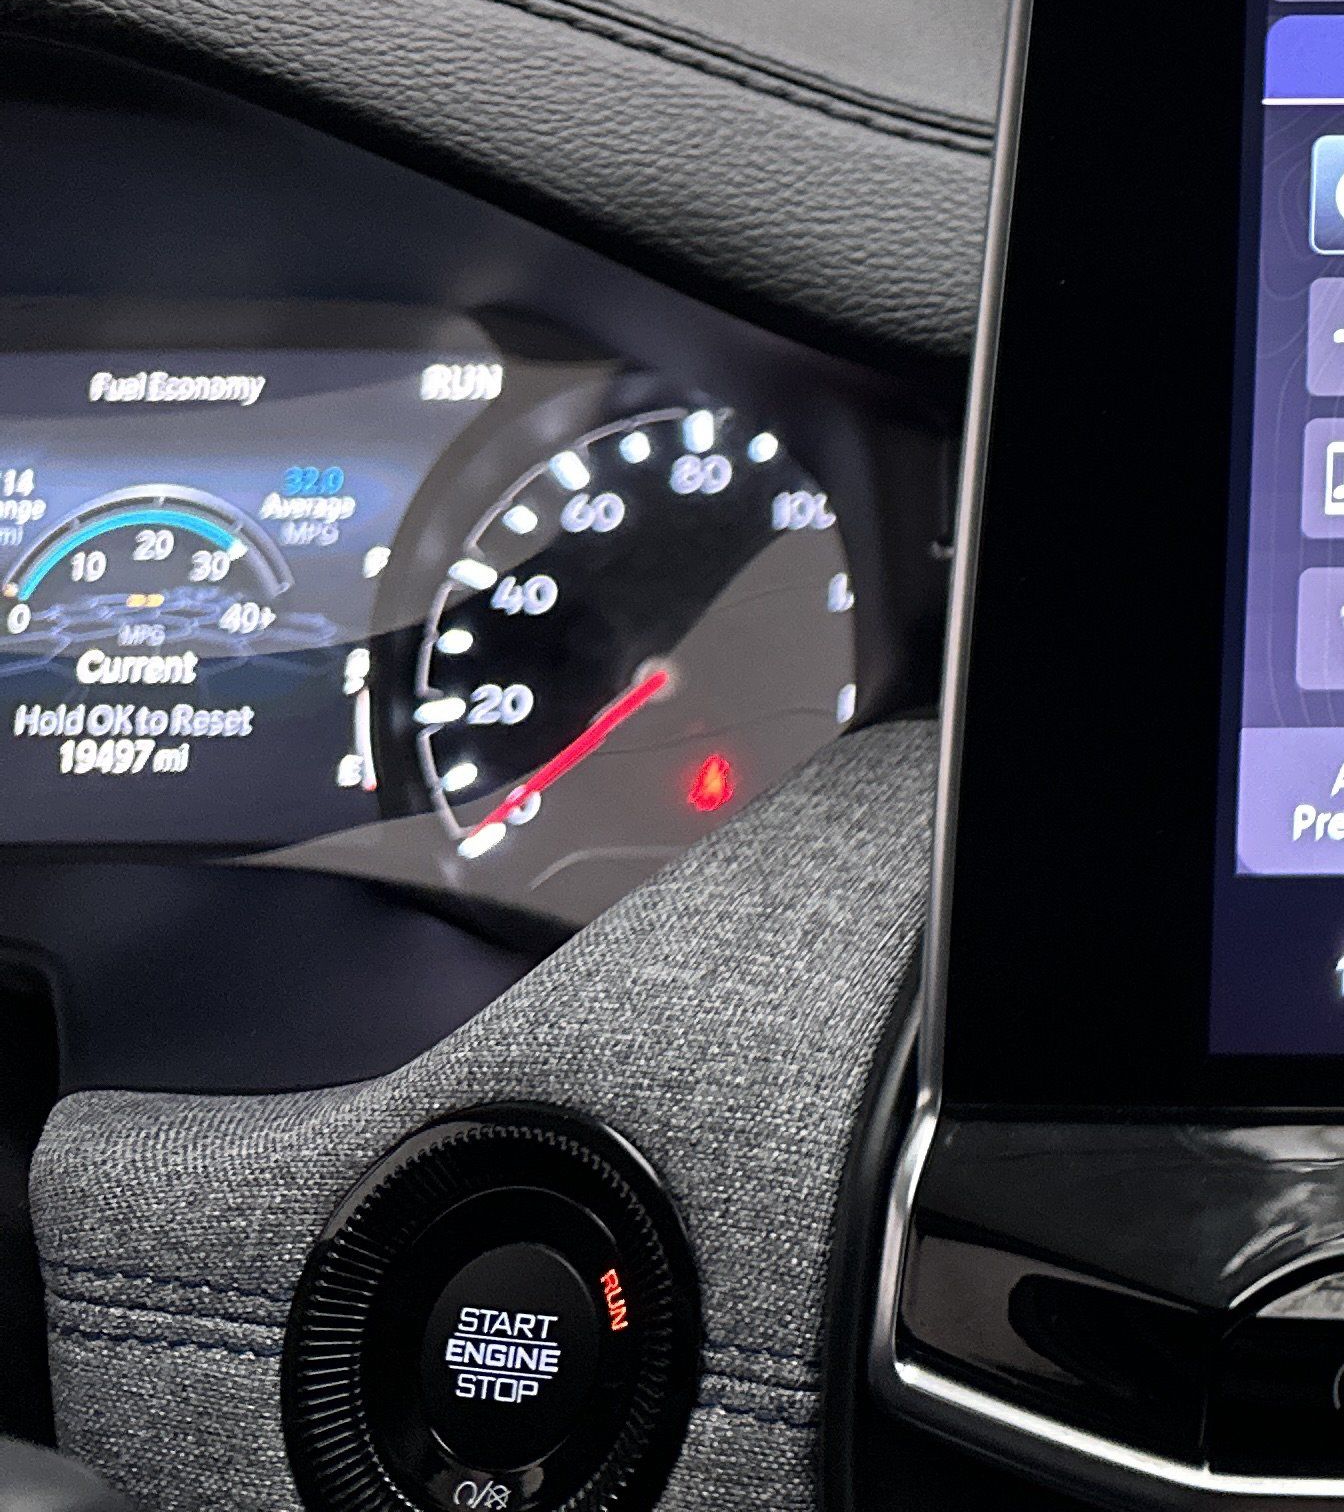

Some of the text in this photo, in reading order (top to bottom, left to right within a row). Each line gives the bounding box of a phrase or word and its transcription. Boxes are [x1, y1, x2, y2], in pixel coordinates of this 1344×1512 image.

[89, 371, 266, 406] Fuel Economy
[421, 363, 503, 400] RUN
[0, 468, 35, 497] 14
[670, 454, 732, 494] 80
[0, 499, 47, 525] nge
[259, 492, 356, 523] Average
[561, 492, 625, 533] 60
[133, 530, 174, 561] 20
[71, 551, 107, 582] 10
[189, 550, 230, 582] 30
[490, 574, 558, 616] 40
[7, 603, 31, 634] 0
[76, 649, 198, 684] Current
[14, 703, 255, 736] Hold OK to Reset
[467, 684, 534, 725] 20
[60, 738, 190, 774] 19497 mi
[601, 1268, 629, 1332] RUN
[456, 1306, 559, 1339] START
[445, 1338, 561, 1373] ENGINE
[455, 1372, 539, 1404] STOP
